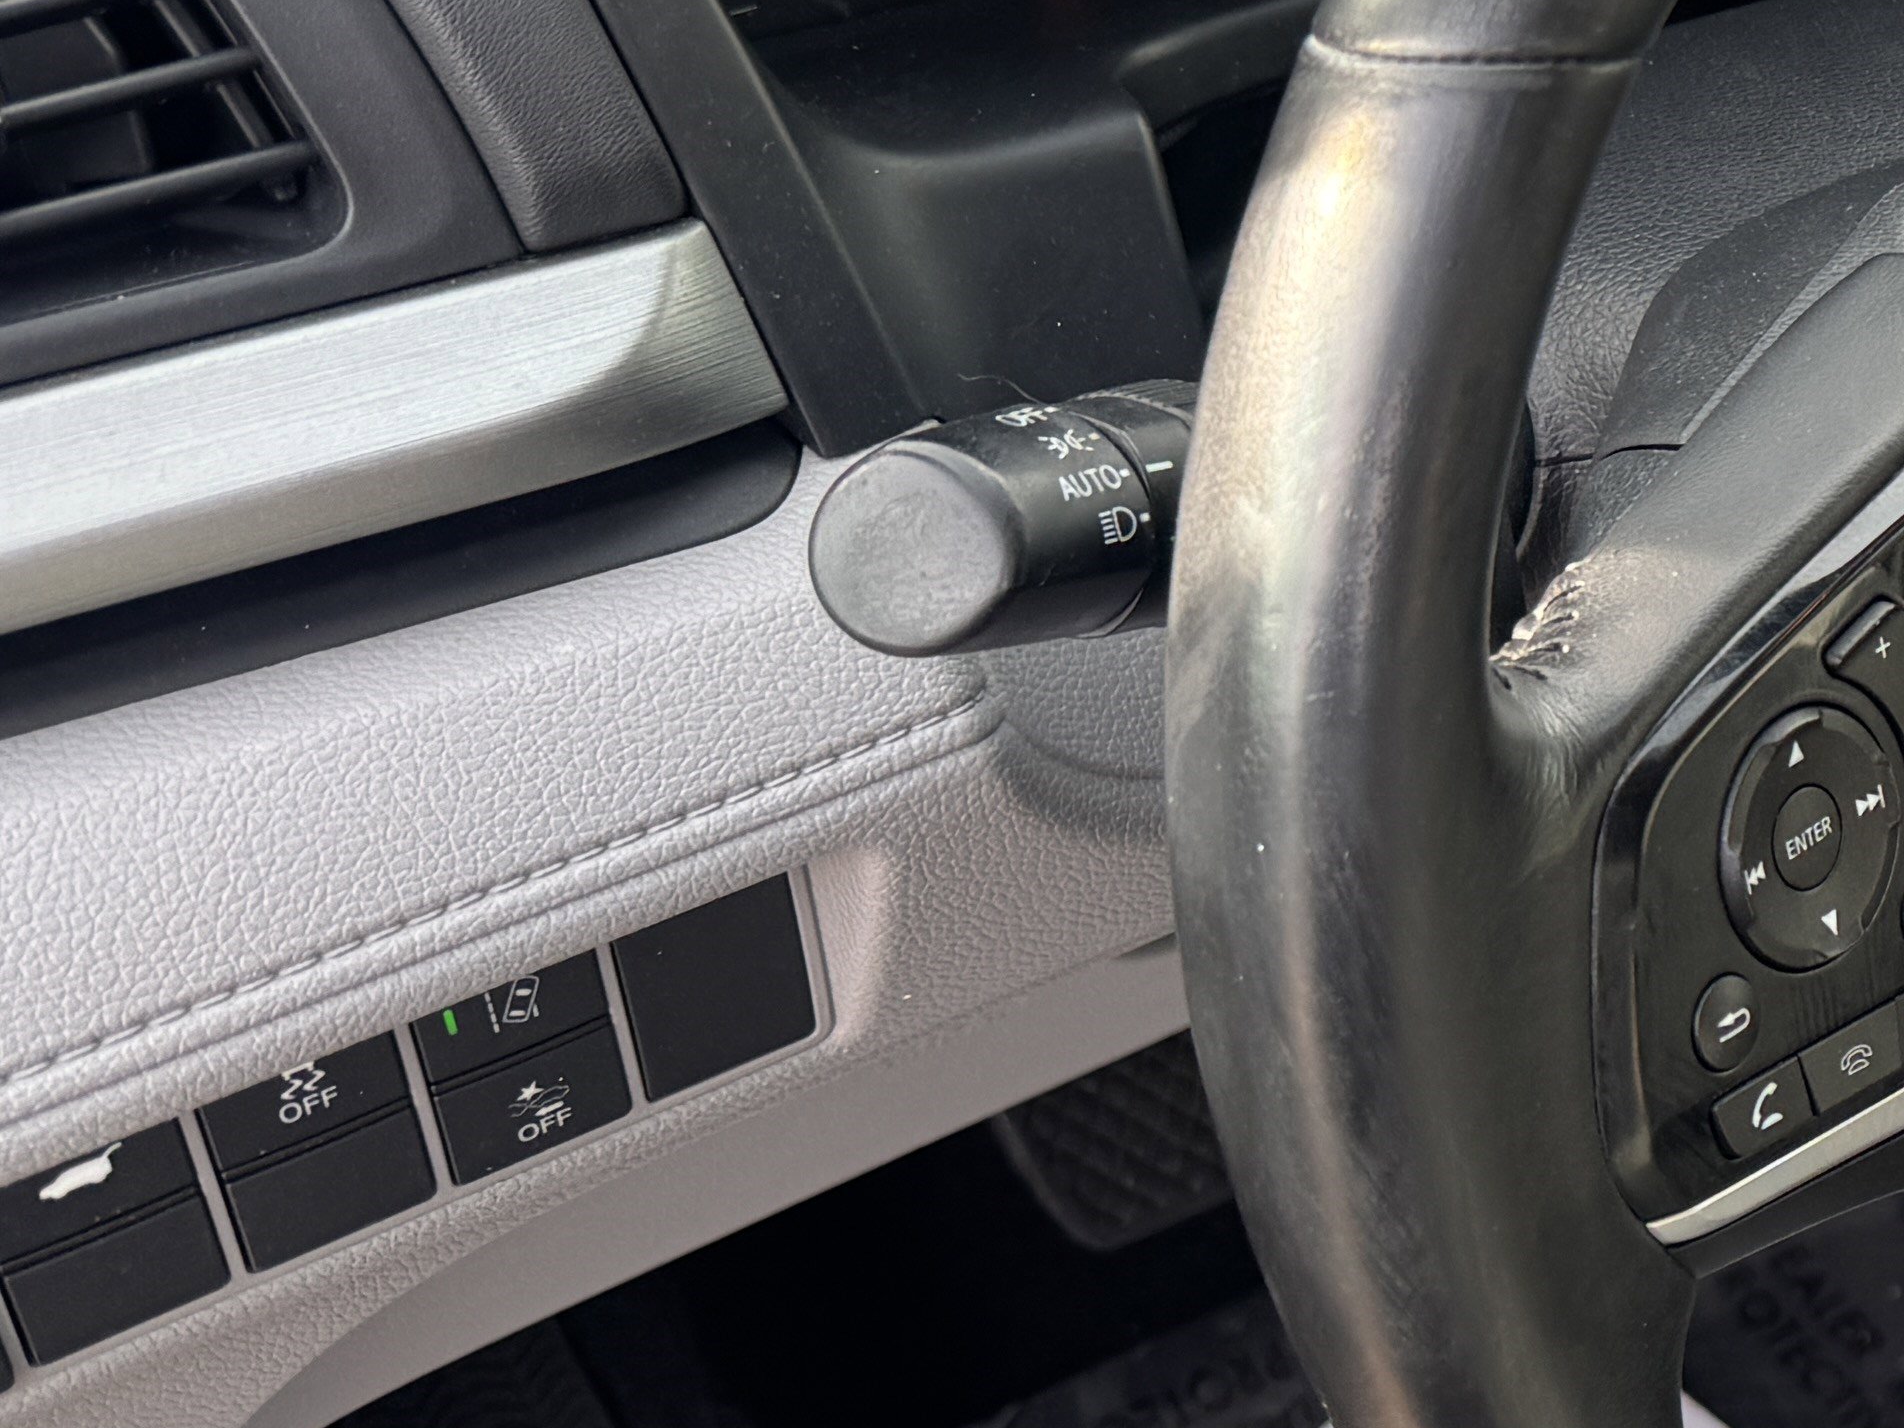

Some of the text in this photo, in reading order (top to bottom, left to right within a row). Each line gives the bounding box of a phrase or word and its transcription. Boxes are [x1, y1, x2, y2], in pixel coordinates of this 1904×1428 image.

[1058, 464, 1122, 502] AUTO
[1784, 815, 1833, 860] ENTER
[278, 1083, 339, 1126] OFF
[517, 1104, 574, 1144] OFF
